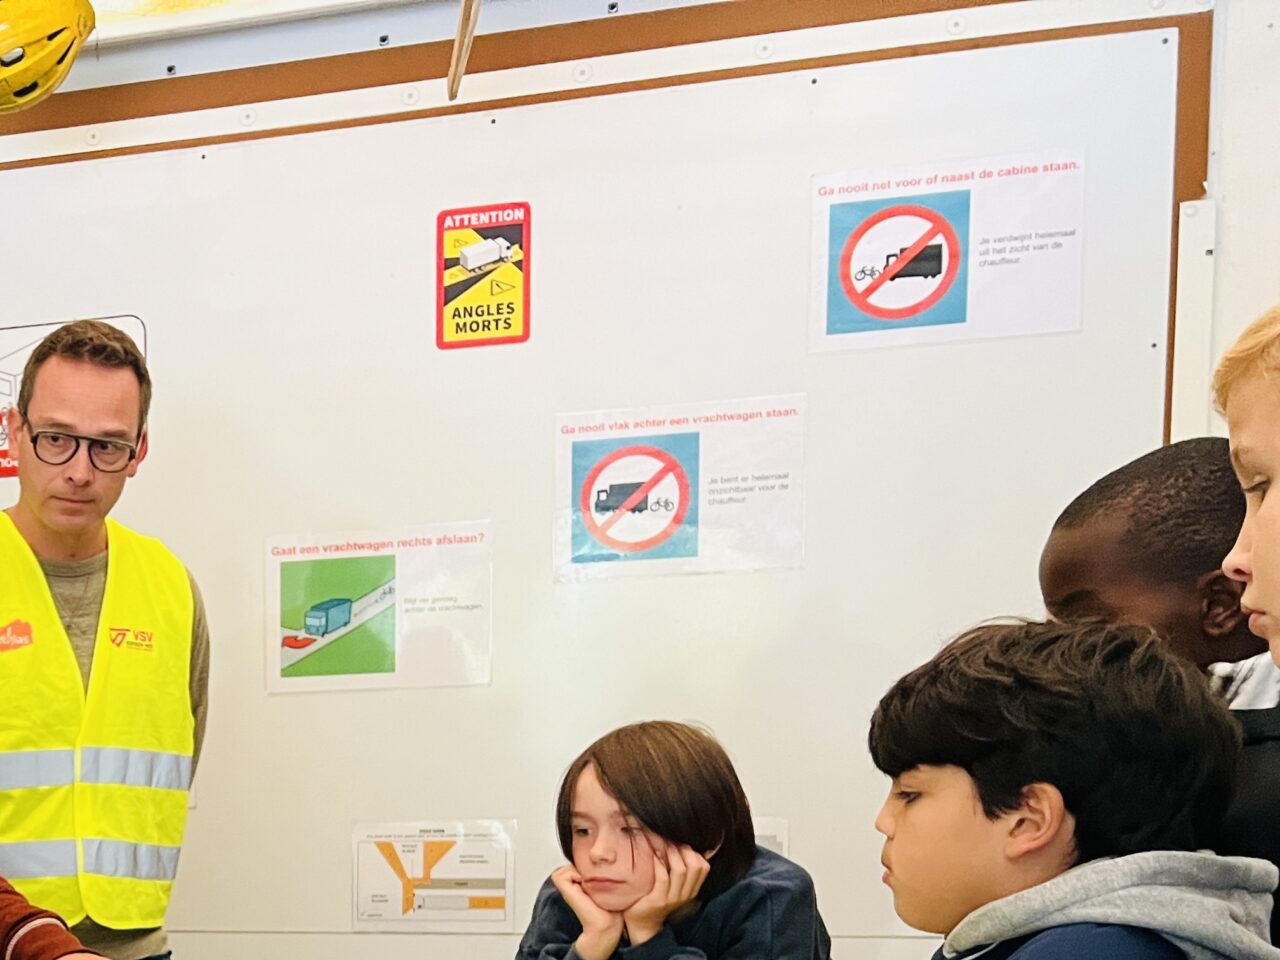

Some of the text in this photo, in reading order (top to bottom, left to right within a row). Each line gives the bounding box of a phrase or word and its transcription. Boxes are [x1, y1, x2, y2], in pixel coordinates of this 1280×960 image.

[818, 186, 835, 197] Ga
[838, 183, 868, 195] nooit
[895, 177, 923, 188] voor
[926, 174, 938, 185] of
[941, 171, 975, 183] naast
[979, 169, 993, 180] de
[997, 164, 1039, 178] cabine
[1042, 161, 1080, 173] staan.
[444, 208, 525, 229] ATTENTION
[452, 302, 516, 320] ANGLES
[455, 317, 513, 335] MORTS
[561, 425, 576, 435] Ga
[578, 422, 605, 433] nooit
[608, 420, 630, 431] vlak
[633, 418, 667, 429] achter
[669, 416, 689, 426] een
[692, 410, 763, 425] vrachtwagen
[271, 532, 486, 557] Gaat een vrachtwagen rechts afslaan?
[132, 630, 153, 642] VSV
